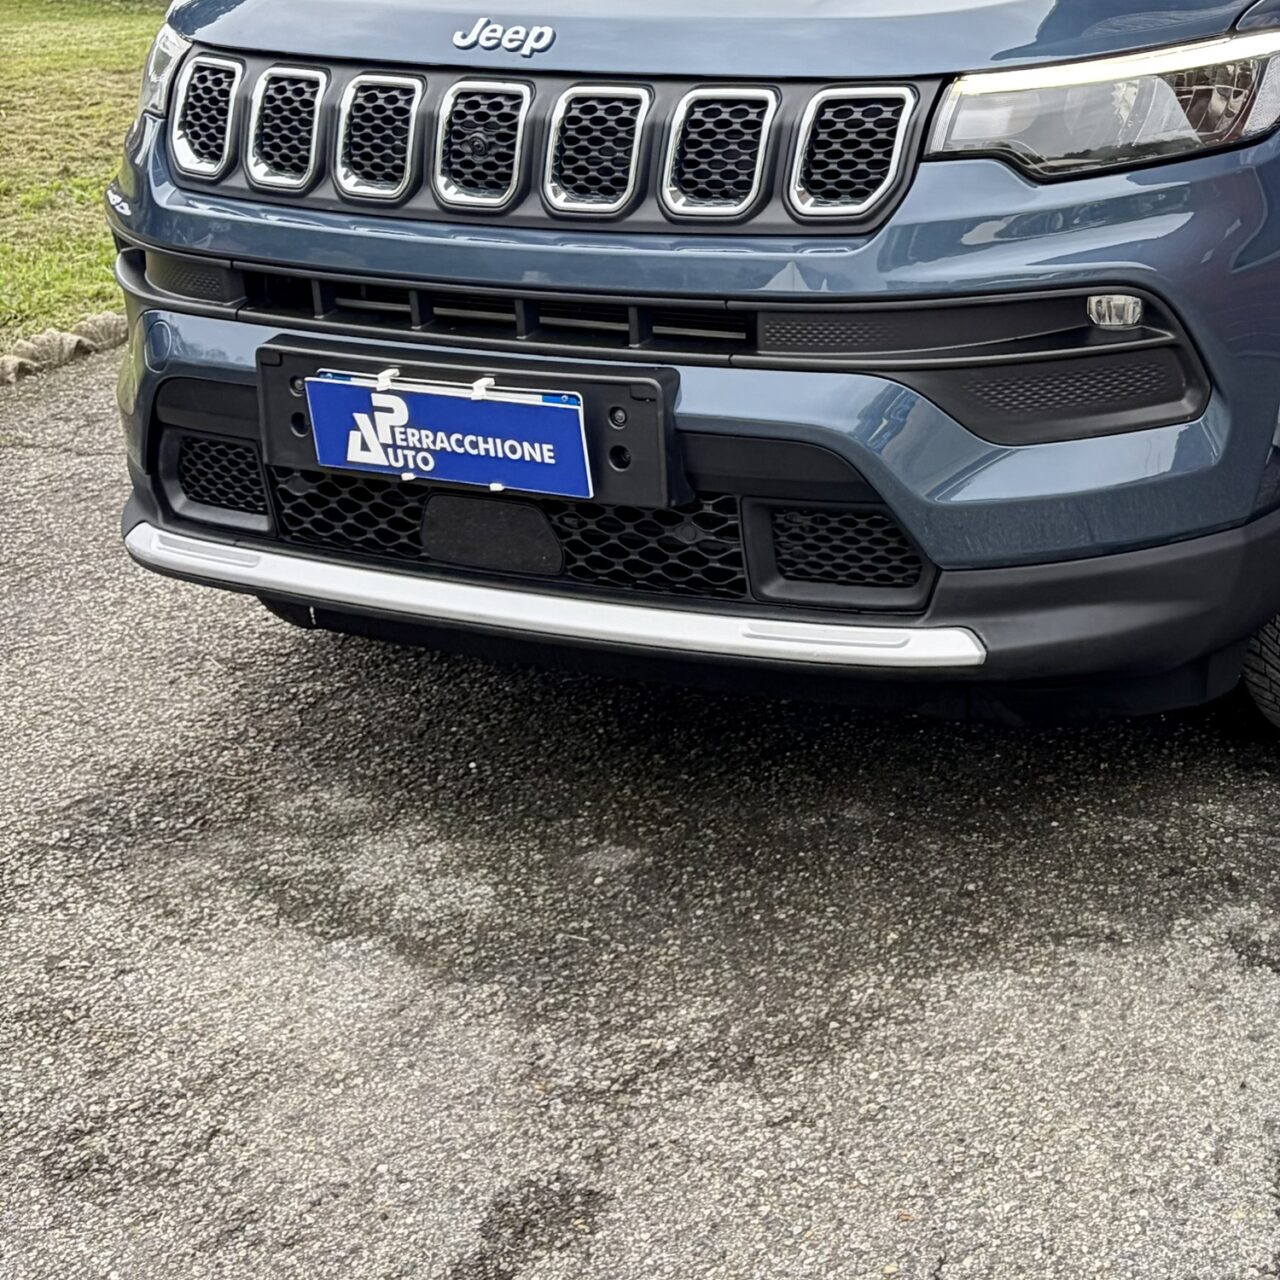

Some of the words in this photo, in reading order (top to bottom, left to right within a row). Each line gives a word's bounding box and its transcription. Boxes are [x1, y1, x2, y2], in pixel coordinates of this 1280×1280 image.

[452, 17, 556, 58] Jeep
[346, 412, 435, 472] AUTO
[371, 392, 556, 464] PERRACCHIONE
